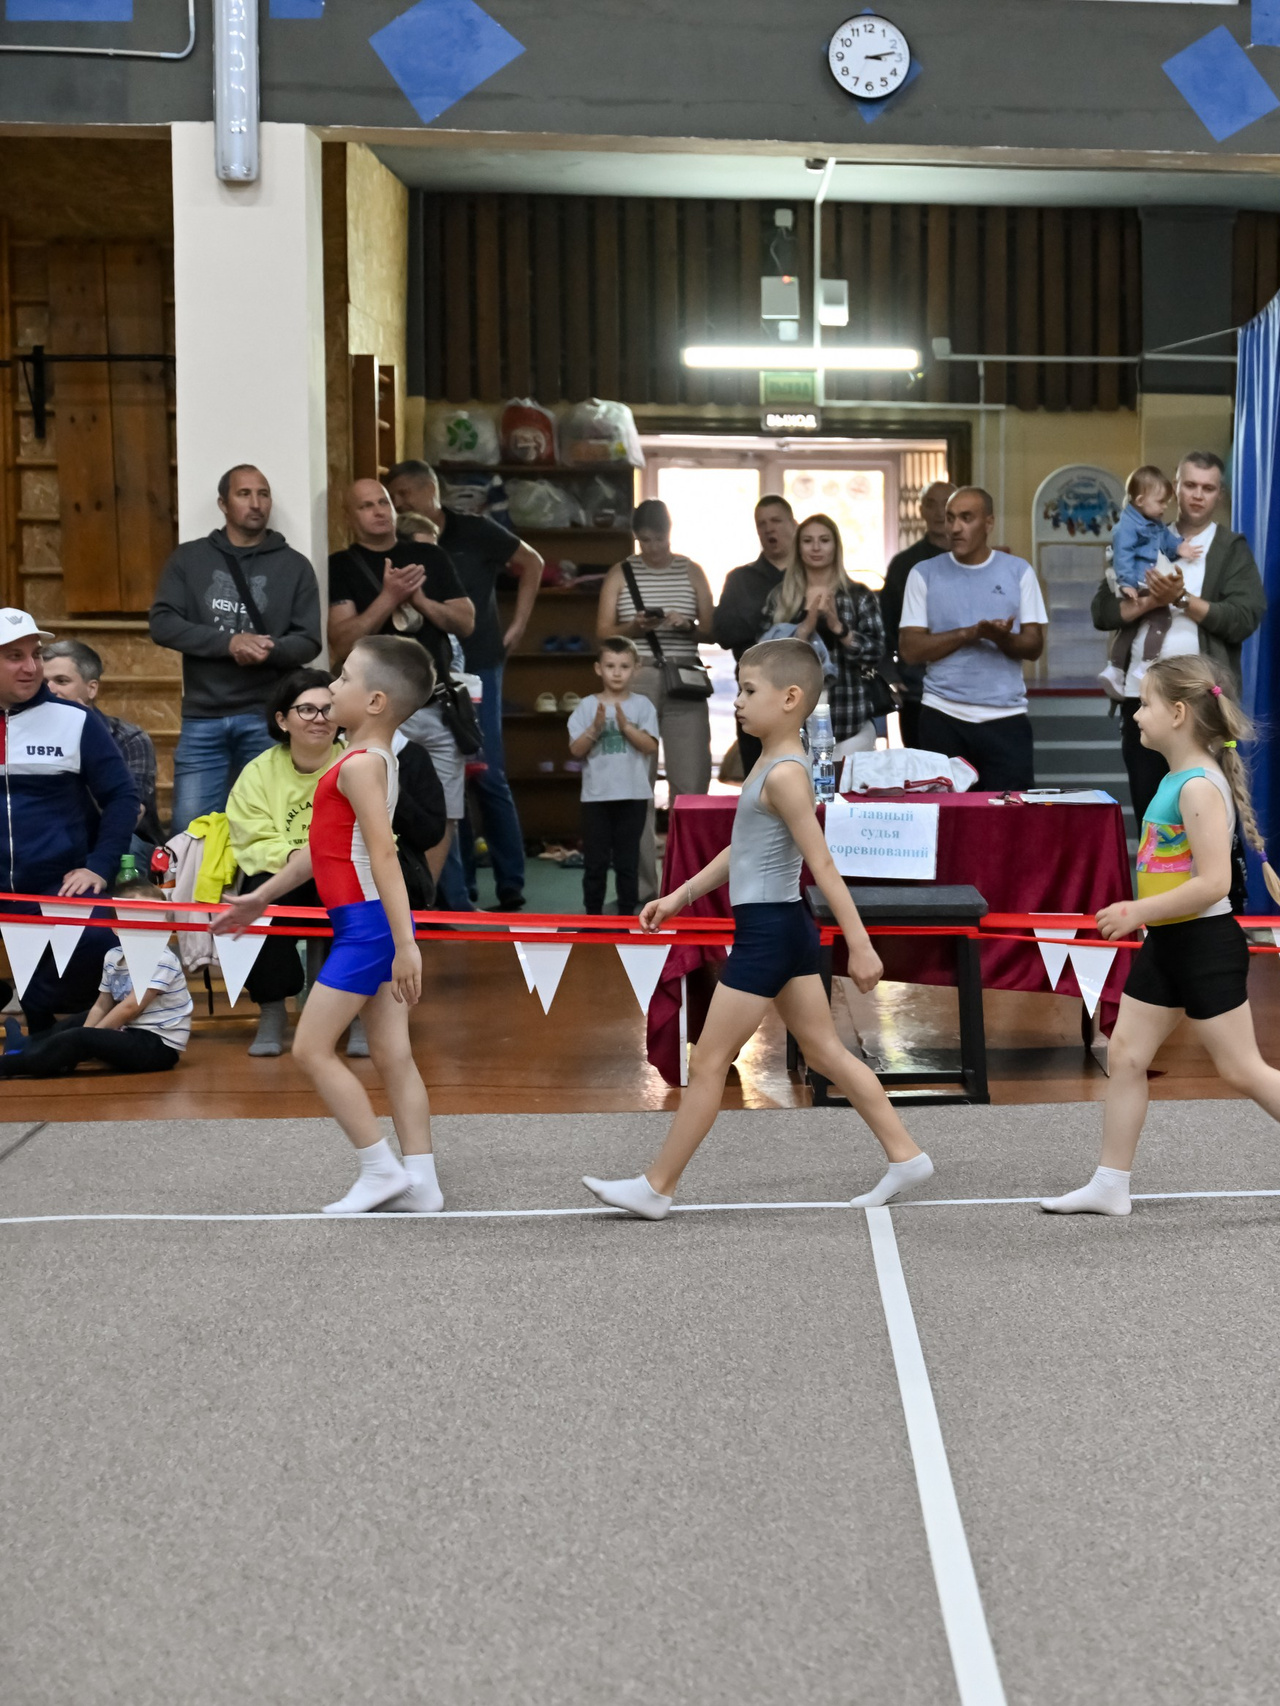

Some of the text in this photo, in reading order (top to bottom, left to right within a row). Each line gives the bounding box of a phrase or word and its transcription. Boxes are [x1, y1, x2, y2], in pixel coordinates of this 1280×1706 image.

[851, 28, 860, 38] 11
[863, 23, 875, 34] 12
[881, 28, 886, 38] 1
[840, 38, 852, 48] 10
[890, 39, 897, 49] 2
[836, 52, 844, 61] 9
[841, 66, 849, 76] 8
[890, 68, 897, 77] 4
[852, 76, 859, 87] 7
[865, 81, 875, 92] 6
[880, 77, 888, 87] 5
[26, 745, 64, 757] USPA
[849, 807, 914, 822] Главный
[285, 808, 299, 832] KARL
[861, 828, 900, 840] судья
[829, 844, 929, 859] соревнований
